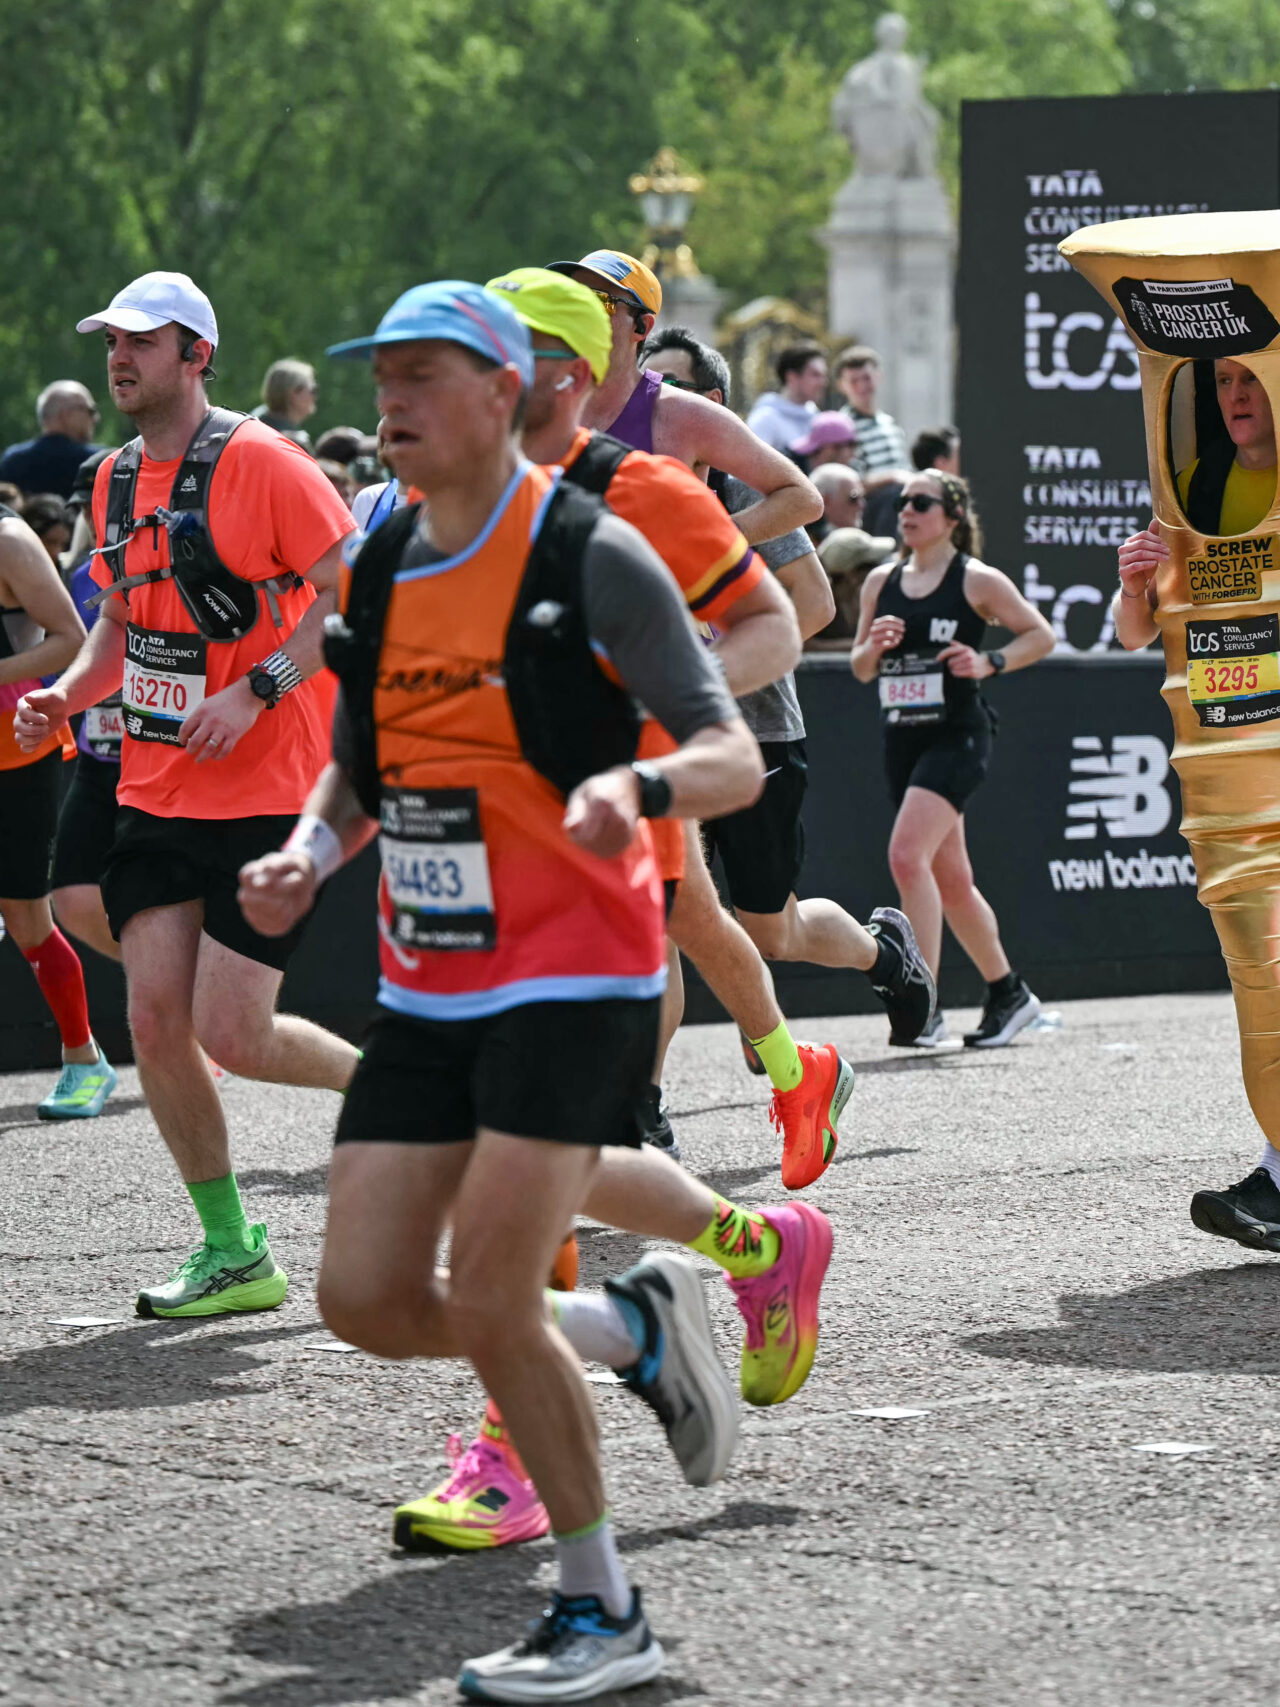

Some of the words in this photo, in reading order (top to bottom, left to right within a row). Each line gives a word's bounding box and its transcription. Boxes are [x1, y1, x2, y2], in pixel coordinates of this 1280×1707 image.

[1026, 170, 1103, 197] TATA
[1157, 286, 1206, 294] PARTNERSHIP
[1207, 282, 1229, 291] WITH
[1152, 301, 1235, 322] PROSTATE
[1160, 320, 1225, 339] CANCER
[1223, 316, 1251, 336] UK
[1024, 445, 1101, 473] TATA
[1023, 480, 1152, 508] CONSULTA
[1207, 537, 1272, 558] SCREW
[1189, 553, 1273, 576] PROSTATE
[1190, 572, 1257, 591] CANCER
[1192, 592, 1211, 601] WITH
[1211, 587, 1257, 600] FORGEFIX
[1190, 629, 1219, 653] tcs
[1221, 626, 1241, 634] TATA
[1223, 630, 1273, 642] CONSULTANCY
[1224, 642, 1255, 651] SERVICES
[145, 654, 177, 666] SERVICES
[146, 645, 198, 658] CONSULTANCY
[1204, 664, 1259, 694] 3295
[130, 673, 187, 711] 15270
[1228, 714, 1245, 722] new
[1048, 858, 1105, 892] new
[1104, 849, 1198, 889] balanc
